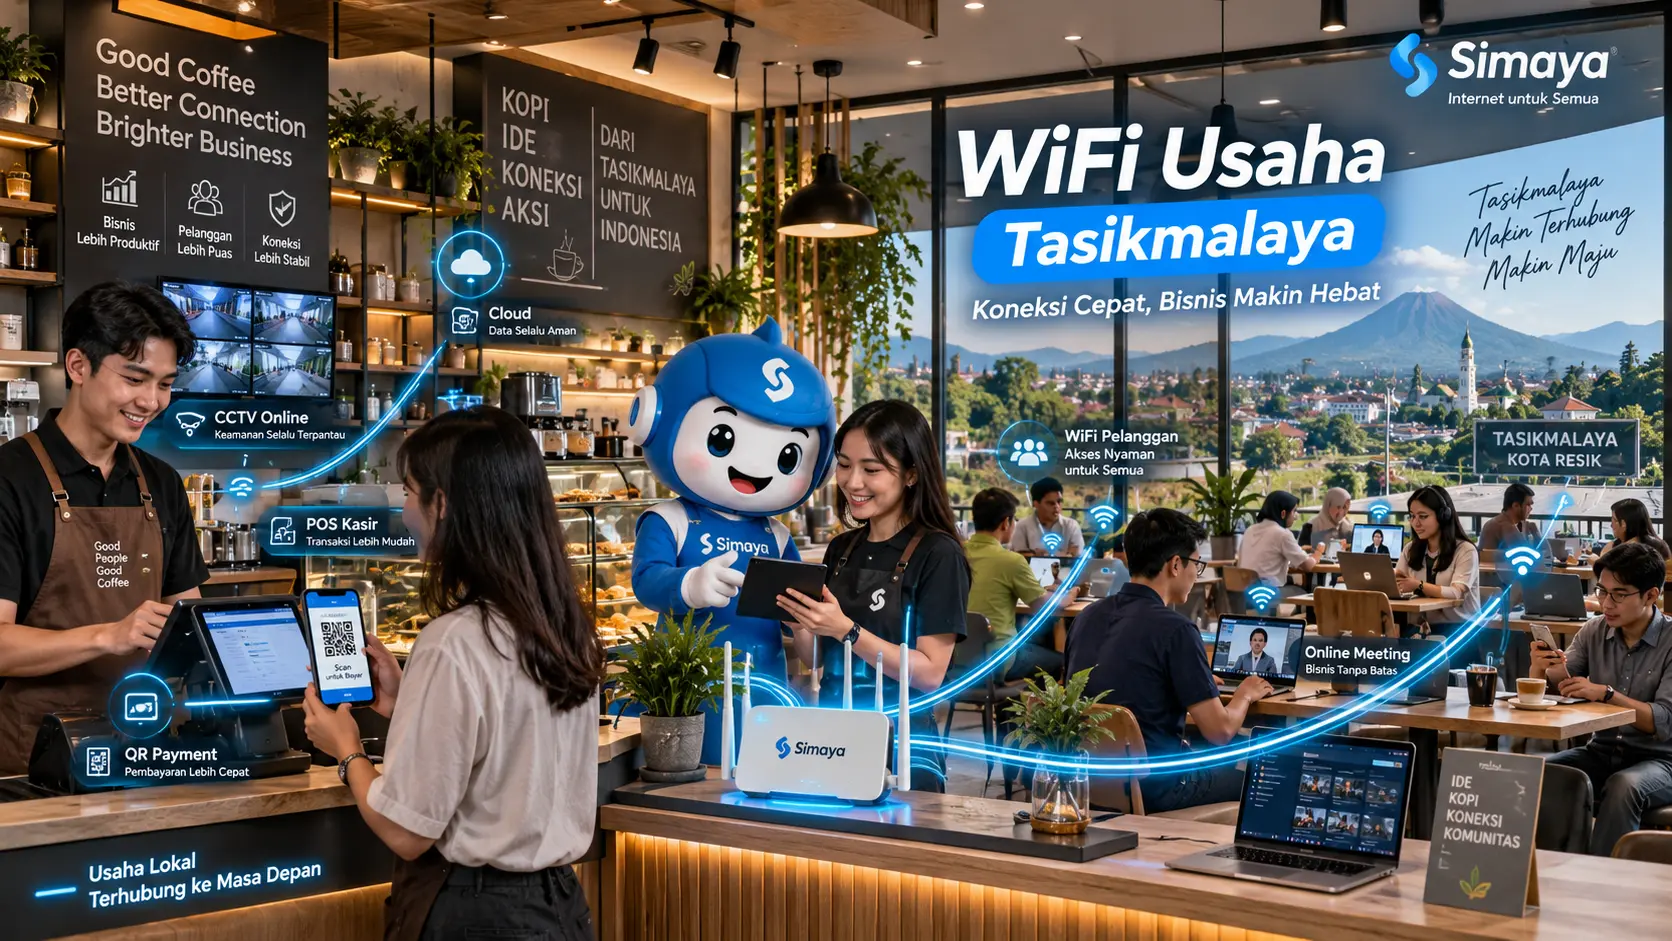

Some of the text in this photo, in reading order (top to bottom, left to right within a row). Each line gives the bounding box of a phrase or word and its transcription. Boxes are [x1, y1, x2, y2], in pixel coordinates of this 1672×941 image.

[97, 38, 256, 95] Good Coffee
[98, 75, 306, 139] Better Connection
[503, 87, 549, 122] KOPI
[98, 110, 293, 167] Brighter Business
[503, 123, 536, 154] IDE
[601, 124, 634, 152] DARI
[503, 160, 583, 199] KONEKSI
[600, 156, 696, 197] TASIKMALAYA
[601, 188, 652, 218] UNTUK
[1469, 168, 1605, 219] Tasikmalaya
[502, 196, 549, 227] AKSI
[104, 216, 135, 230] Bisnis
[1464, 199, 1636, 259] Makin Terhubung
[78, 232, 159, 251] Lebih Produktif
[178, 225, 233, 243] Pelanggan
[263, 235, 300, 249] Koneksi
[602, 219, 681, 252] INDONESIA
[178, 243, 232, 258] Lebih Puas
[255, 251, 309, 267] Lebih Stabil
[1483, 239, 1619, 290] Makin Maju
[1493, 432, 1618, 446] TASIKMALAYA
[1508, 453, 1601, 467] KOTA RESIK
[94, 541, 120, 551] Good
[716, 537, 769, 556] Simaya
[96, 553, 128, 565] People
[97, 566, 122, 575] Good
[98, 578, 129, 588] Coffee
[334, 664, 353, 672] Scan
[795, 742, 845, 759] Simaya
[1451, 775, 1473, 789] IDE
[1449, 792, 1479, 807] KOPI
[1446, 809, 1503, 828] KONEKSI
[1444, 827, 1521, 848] KOMUNITAS
[90, 852, 195, 882] Usaha Lokal
[89, 864, 320, 908] Terhubung ke Masa Depan
